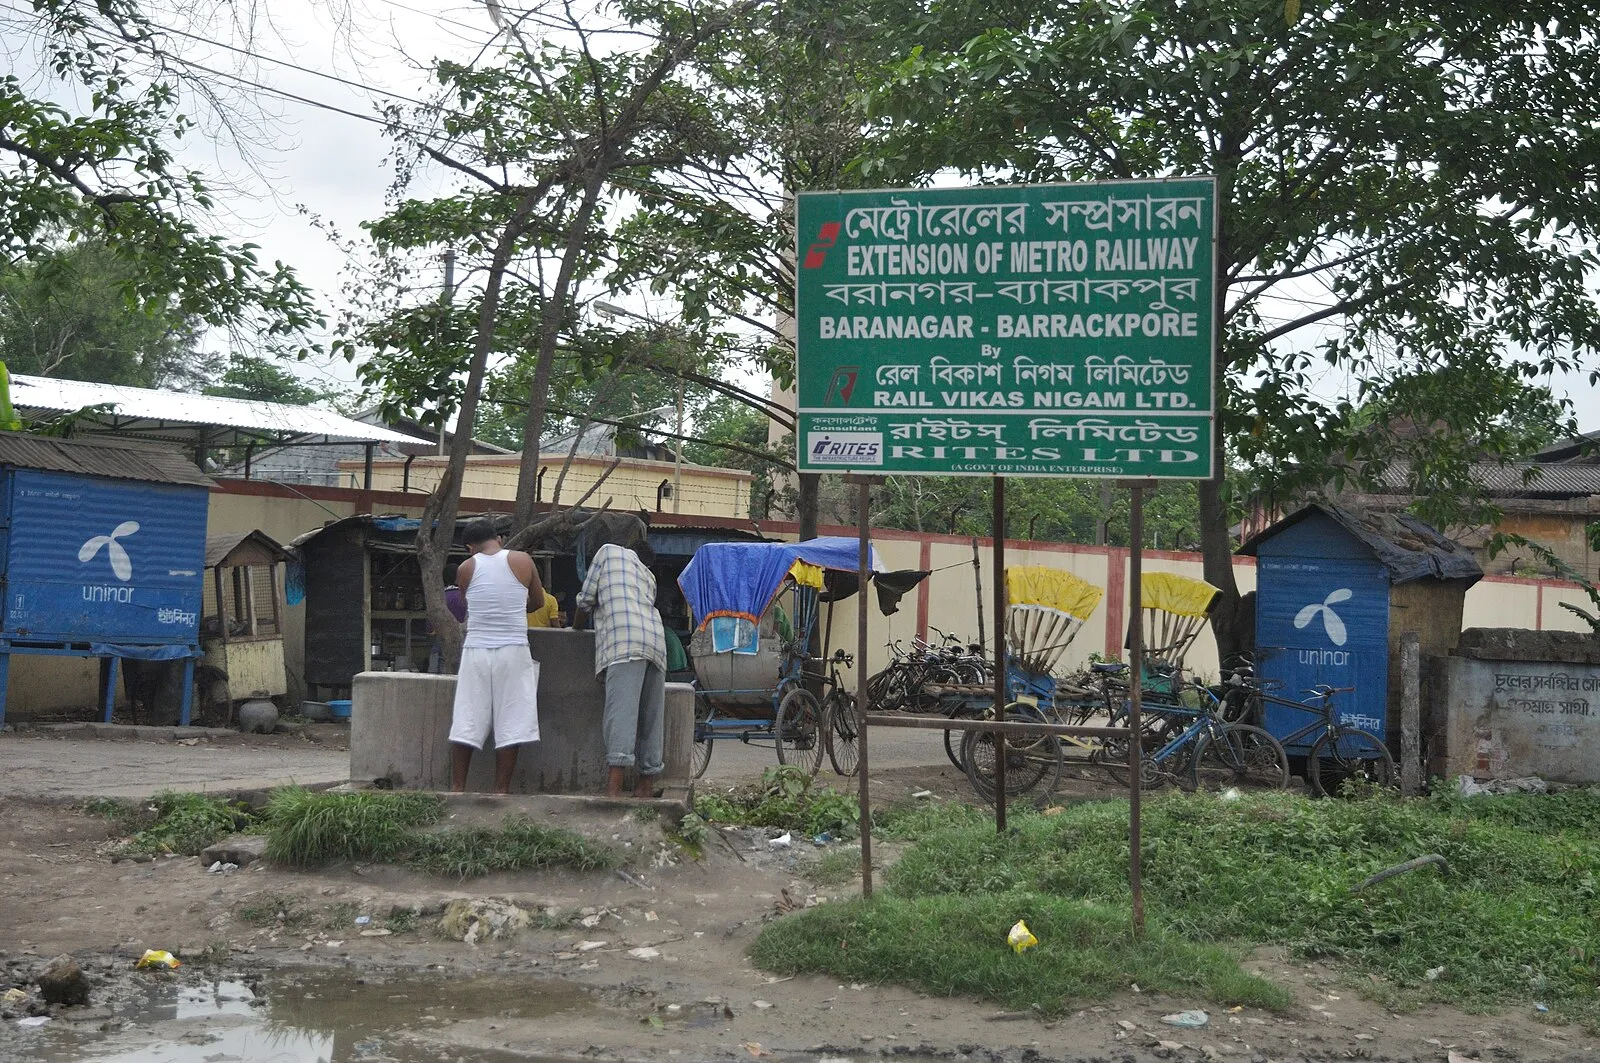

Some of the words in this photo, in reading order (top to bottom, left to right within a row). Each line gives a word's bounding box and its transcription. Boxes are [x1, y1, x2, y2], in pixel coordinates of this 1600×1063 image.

[845, 196, 1030, 241] মেট্রোরেলের
[847, 242, 968, 276] EXTENSION
[974, 241, 1004, 275] OF
[1010, 239, 1088, 273] METRO
[1095, 236, 1199, 271] RAILWAY
[819, 315, 974, 339] BARANAGAR
[996, 312, 1199, 338] BARRACKPORE
[981, 343, 1001, 359] By
[875, 363, 921, 386] রেল
[929, 355, 1003, 386] বিকাশ
[1013, 354, 1075, 386] নিগম
[1084, 354, 1192, 386] লিমিটেড
[873, 390, 934, 407] RAIL
[941, 391, 1025, 407] VIKAS
[1034, 391, 1127, 408] NIGAM
[1135, 392, 1196, 409] LTD.
[1027, 418, 1199, 443] লিমিটেড
[829, 442, 880, 456] RITES
[888, 445, 1063, 461] RITES
[1080, 447, 1199, 463] LTD
[1049, 465, 1124, 474] ENTERPRISE)
[83, 584, 134, 603] uninor
[1299, 648, 1350, 666] uninor
